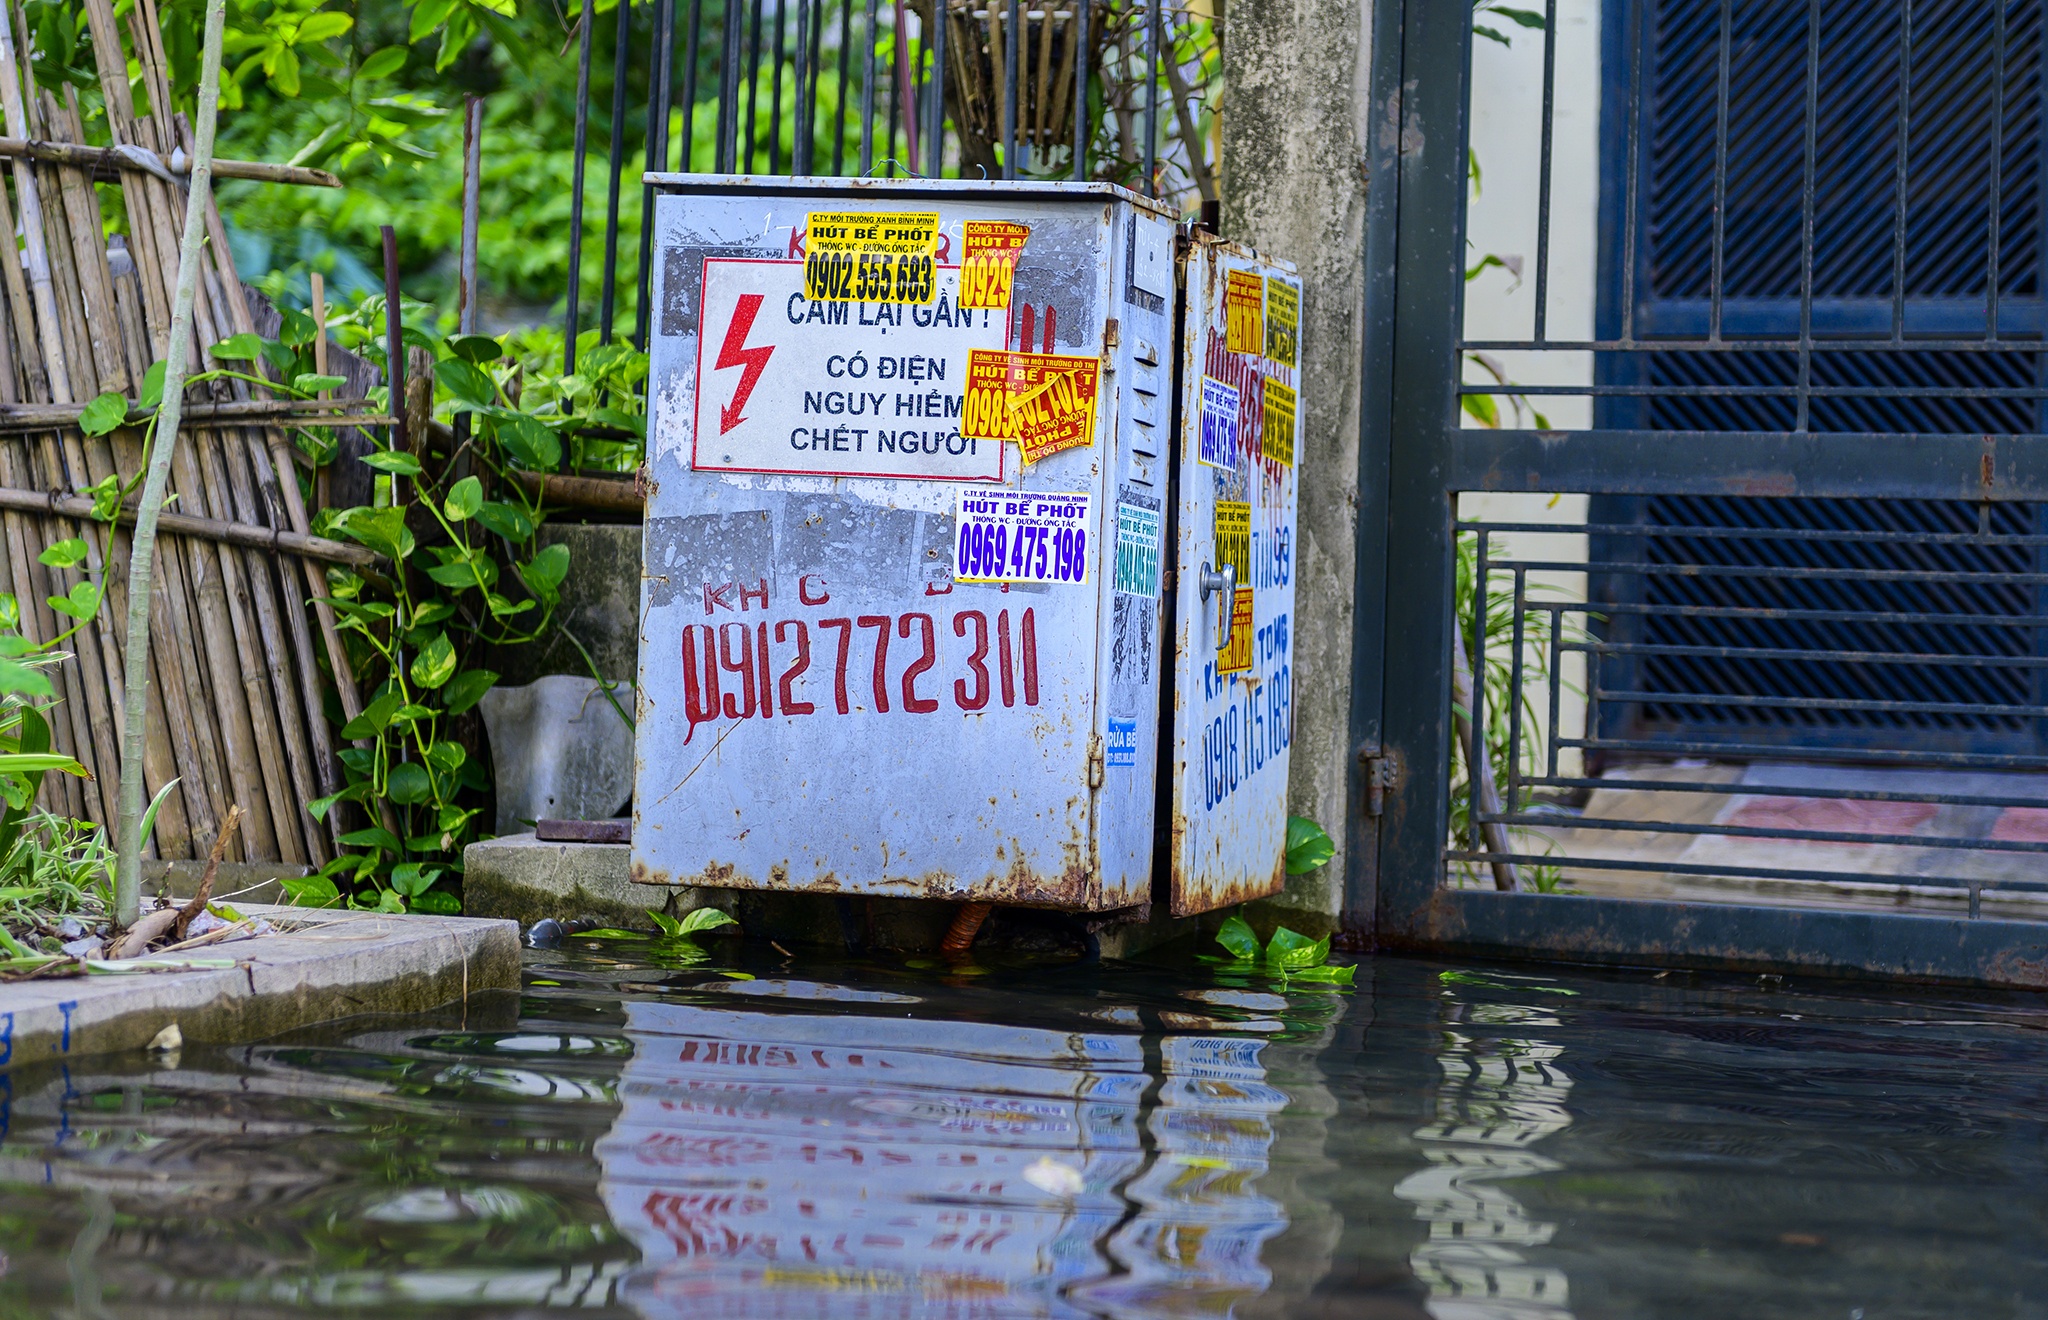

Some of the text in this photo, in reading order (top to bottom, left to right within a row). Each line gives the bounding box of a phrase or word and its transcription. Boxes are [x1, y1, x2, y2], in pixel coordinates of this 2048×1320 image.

[917, 217, 935, 225] MINH
[968, 222, 992, 233] CÔNG
[994, 224, 1005, 232] TY
[813, 225, 848, 239] HÚT
[845, 242, 858, 252] WC
[968, 234, 1004, 247] HÚT
[807, 251, 932, 302] 0902.555.683
[827, 350, 946, 385] CÓ ĐIỆN
[1013, 356, 1029, 365] SINH
[973, 364, 1008, 379] HÚT
[804, 391, 887, 416] NGUY
[790, 424, 869, 452] CHẾT
[963, 499, 999, 514] HÚT
[1037, 502, 1087, 519] PHỐT
[998, 517, 1010, 525] WC
[958, 522, 1086, 583] 0969.475.198
